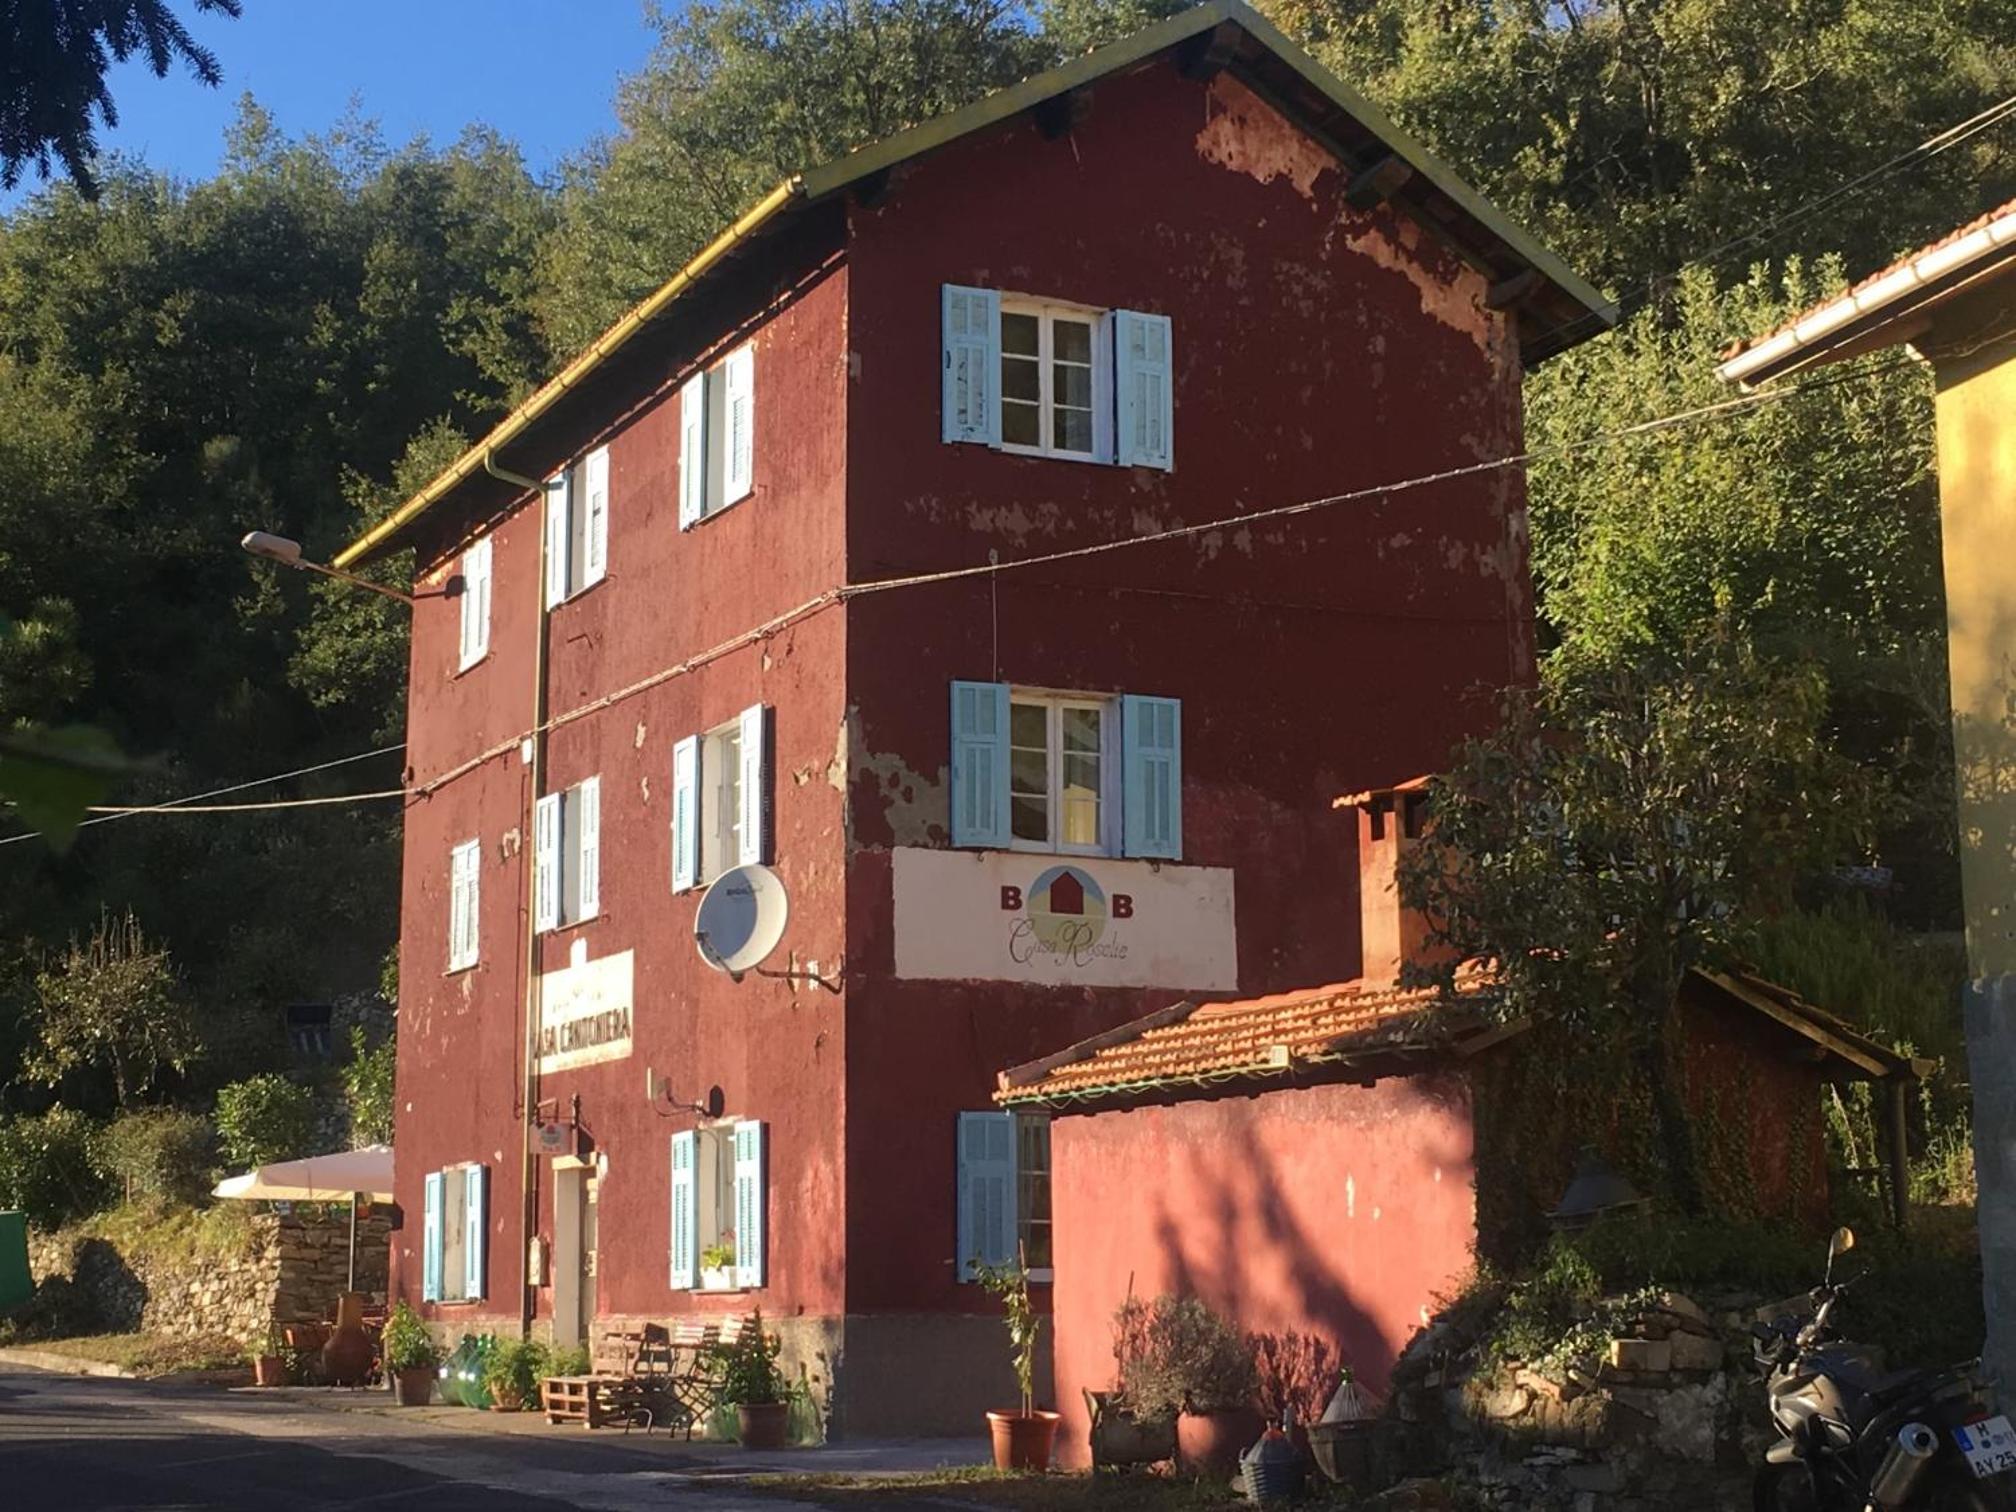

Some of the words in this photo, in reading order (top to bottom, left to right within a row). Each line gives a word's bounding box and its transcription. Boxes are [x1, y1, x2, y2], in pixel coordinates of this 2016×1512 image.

[1001, 885, 1023, 911] B
[1112, 893, 1134, 918] B
[1975, 1458, 1995, 1475] AY
